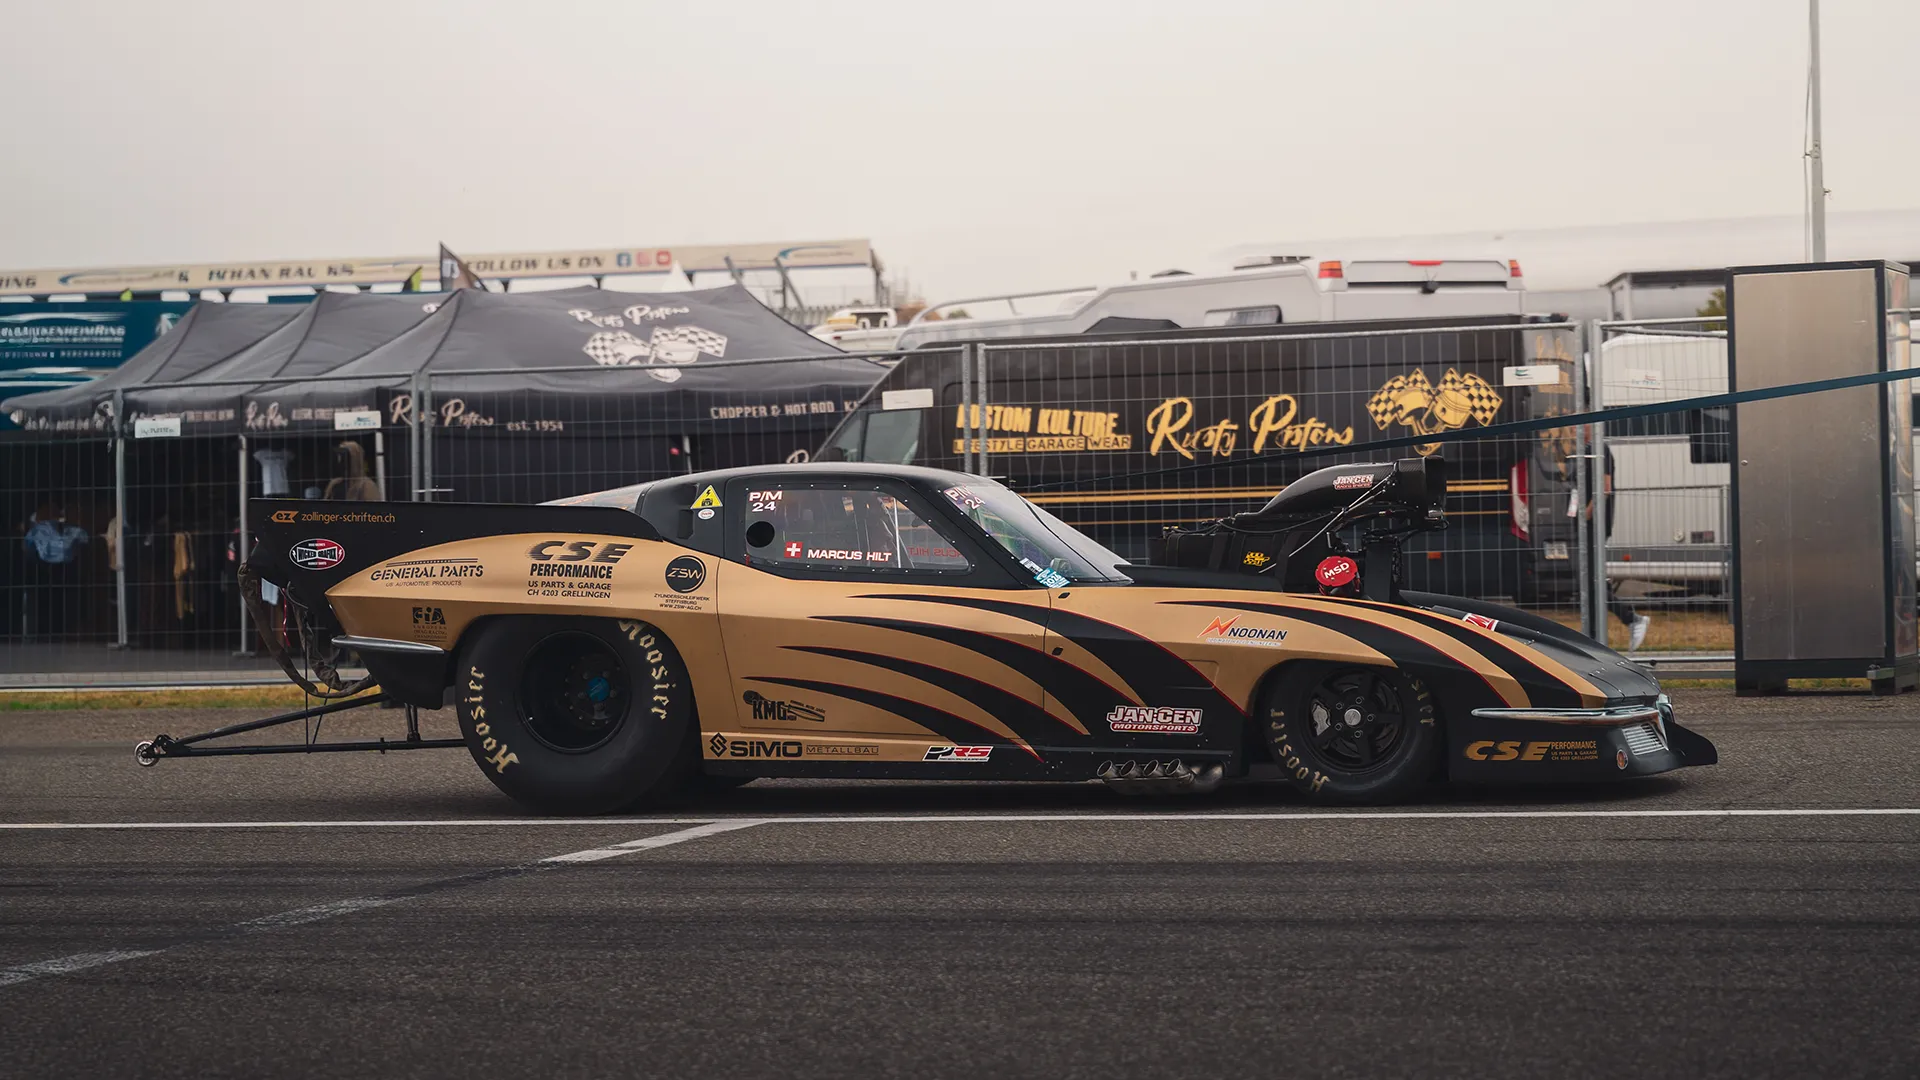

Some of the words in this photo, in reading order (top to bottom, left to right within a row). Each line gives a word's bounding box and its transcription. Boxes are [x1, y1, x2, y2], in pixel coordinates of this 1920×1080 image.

[547, 256, 571, 270] US
[578, 254, 605, 268] ON
[710, 406, 768, 420] CHOPPER
[770, 405, 781, 418] &
[784, 404, 807, 415] HOT
[811, 401, 835, 414] ROD
[507, 421, 531, 431] est.
[535, 420, 564, 432] 1954
[1037, 408, 1120, 438] KULTURE
[1147, 397, 1239, 460] Rusty
[1250, 394, 1354, 455] Pistons
[953, 437, 1025, 454] LFESTYLE
[1026, 435, 1086, 451] GARAGE
[1087, 434, 1132, 450] WEAR
[748, 490, 783, 502] P/M
[752, 501, 776, 512] 24
[301, 511, 396, 524] zollinger-schriften.ch
[526, 540, 634, 564] CSE
[807, 548, 863, 561] MARCUS
[866, 551, 892, 562] HILT
[370, 566, 437, 581] GENERAL
[440, 564, 484, 578] PARTS
[529, 563, 613, 579] PERFORMANCE
[667, 567, 702, 579] ZSW
[1324, 562, 1349, 579] MSD
[528, 580, 539, 588] US
[577, 582, 611, 590] GARAGE
[561, 590, 611, 599] GRELLINGEN
[1228, 627, 1288, 640] NOONAN
[753, 700, 787, 720] KMG
[464, 665, 520, 774] Hoosier
[1112, 722, 1196, 732] MOTORSPORTS
[806, 745, 879, 754] METALLBAU
[1463, 740, 1551, 760] CSE
[1551, 741, 1597, 750] PERFORMANCE
